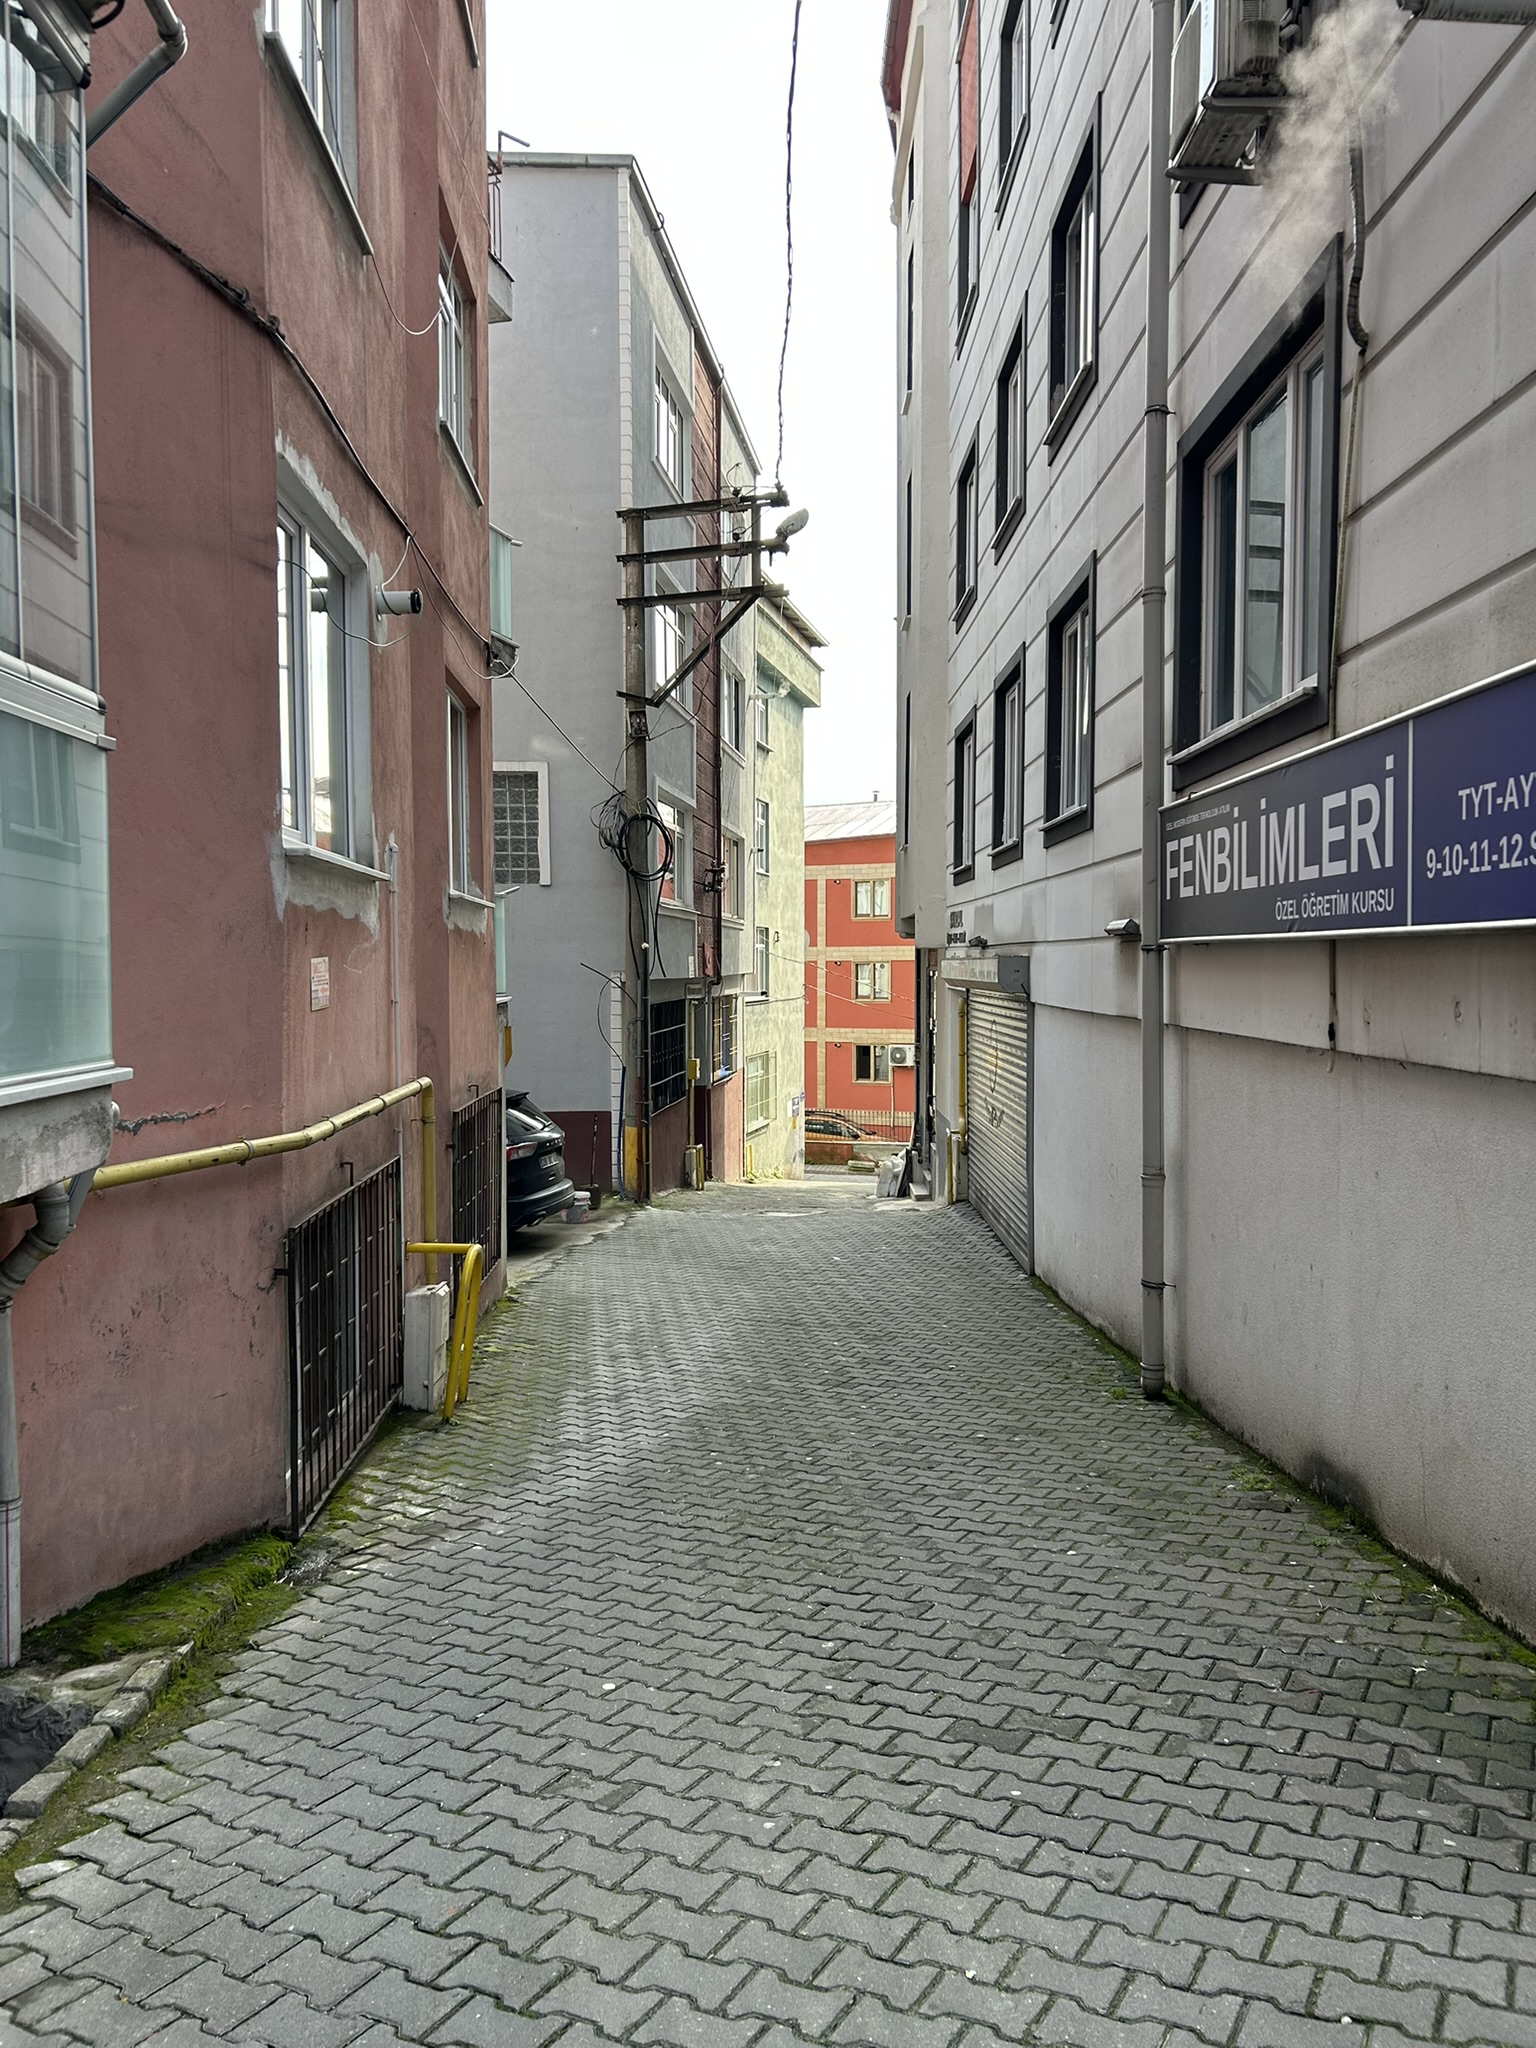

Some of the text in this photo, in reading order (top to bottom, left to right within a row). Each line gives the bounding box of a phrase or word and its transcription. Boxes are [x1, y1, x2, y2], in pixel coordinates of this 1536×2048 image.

[1458, 771, 1536, 820] TYT-AY
[1275, 887, 1395, 920] ÖZEL ÖĞRETİM KURSU
